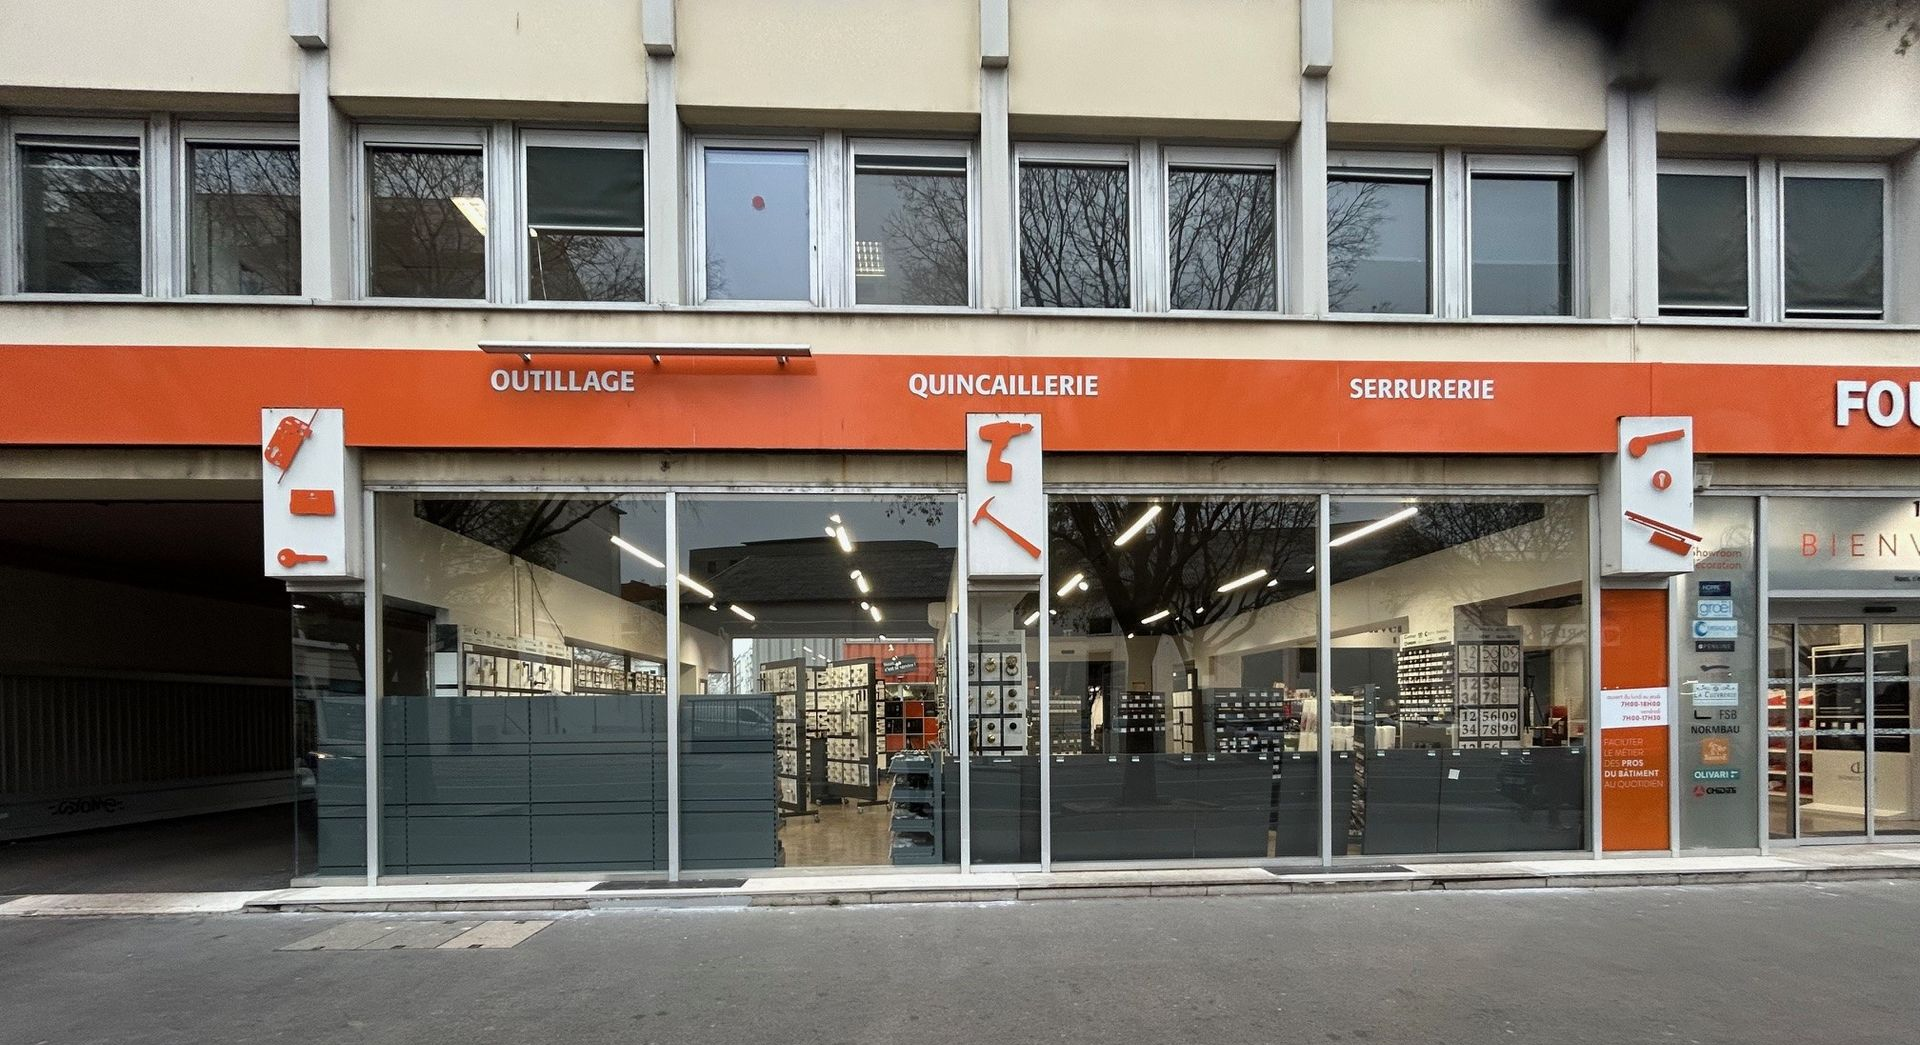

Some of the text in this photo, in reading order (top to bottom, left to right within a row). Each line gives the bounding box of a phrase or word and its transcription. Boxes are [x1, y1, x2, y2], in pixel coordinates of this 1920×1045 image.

[490, 369, 635, 391] OUTILLAGE
[908, 373, 1099, 399] QUINCAILLERIE
[1349, 378, 1494, 399] SERRURERIE
[1693, 547, 1742, 558] howroom
[1461, 678, 1499, 690] 12 56
[1461, 692, 1499, 704] 34 78
[1462, 711, 1517, 722] 12 56 09
[1719, 709, 1738, 720] FSB
[1462, 724, 1517, 735] 34 78 90
[1691, 725, 1740, 734] NORMBAU
[1604, 738, 1644, 746] FACILITER
[1604, 748, 1613, 757] LE
[1604, 759, 1644, 767] DES PROS
[1604, 768, 1660, 778] DU BÂTIMENT
[1694, 771, 1729, 779] OLIVARI
[1604, 779, 1664, 789] AU QUOTIDIEN
